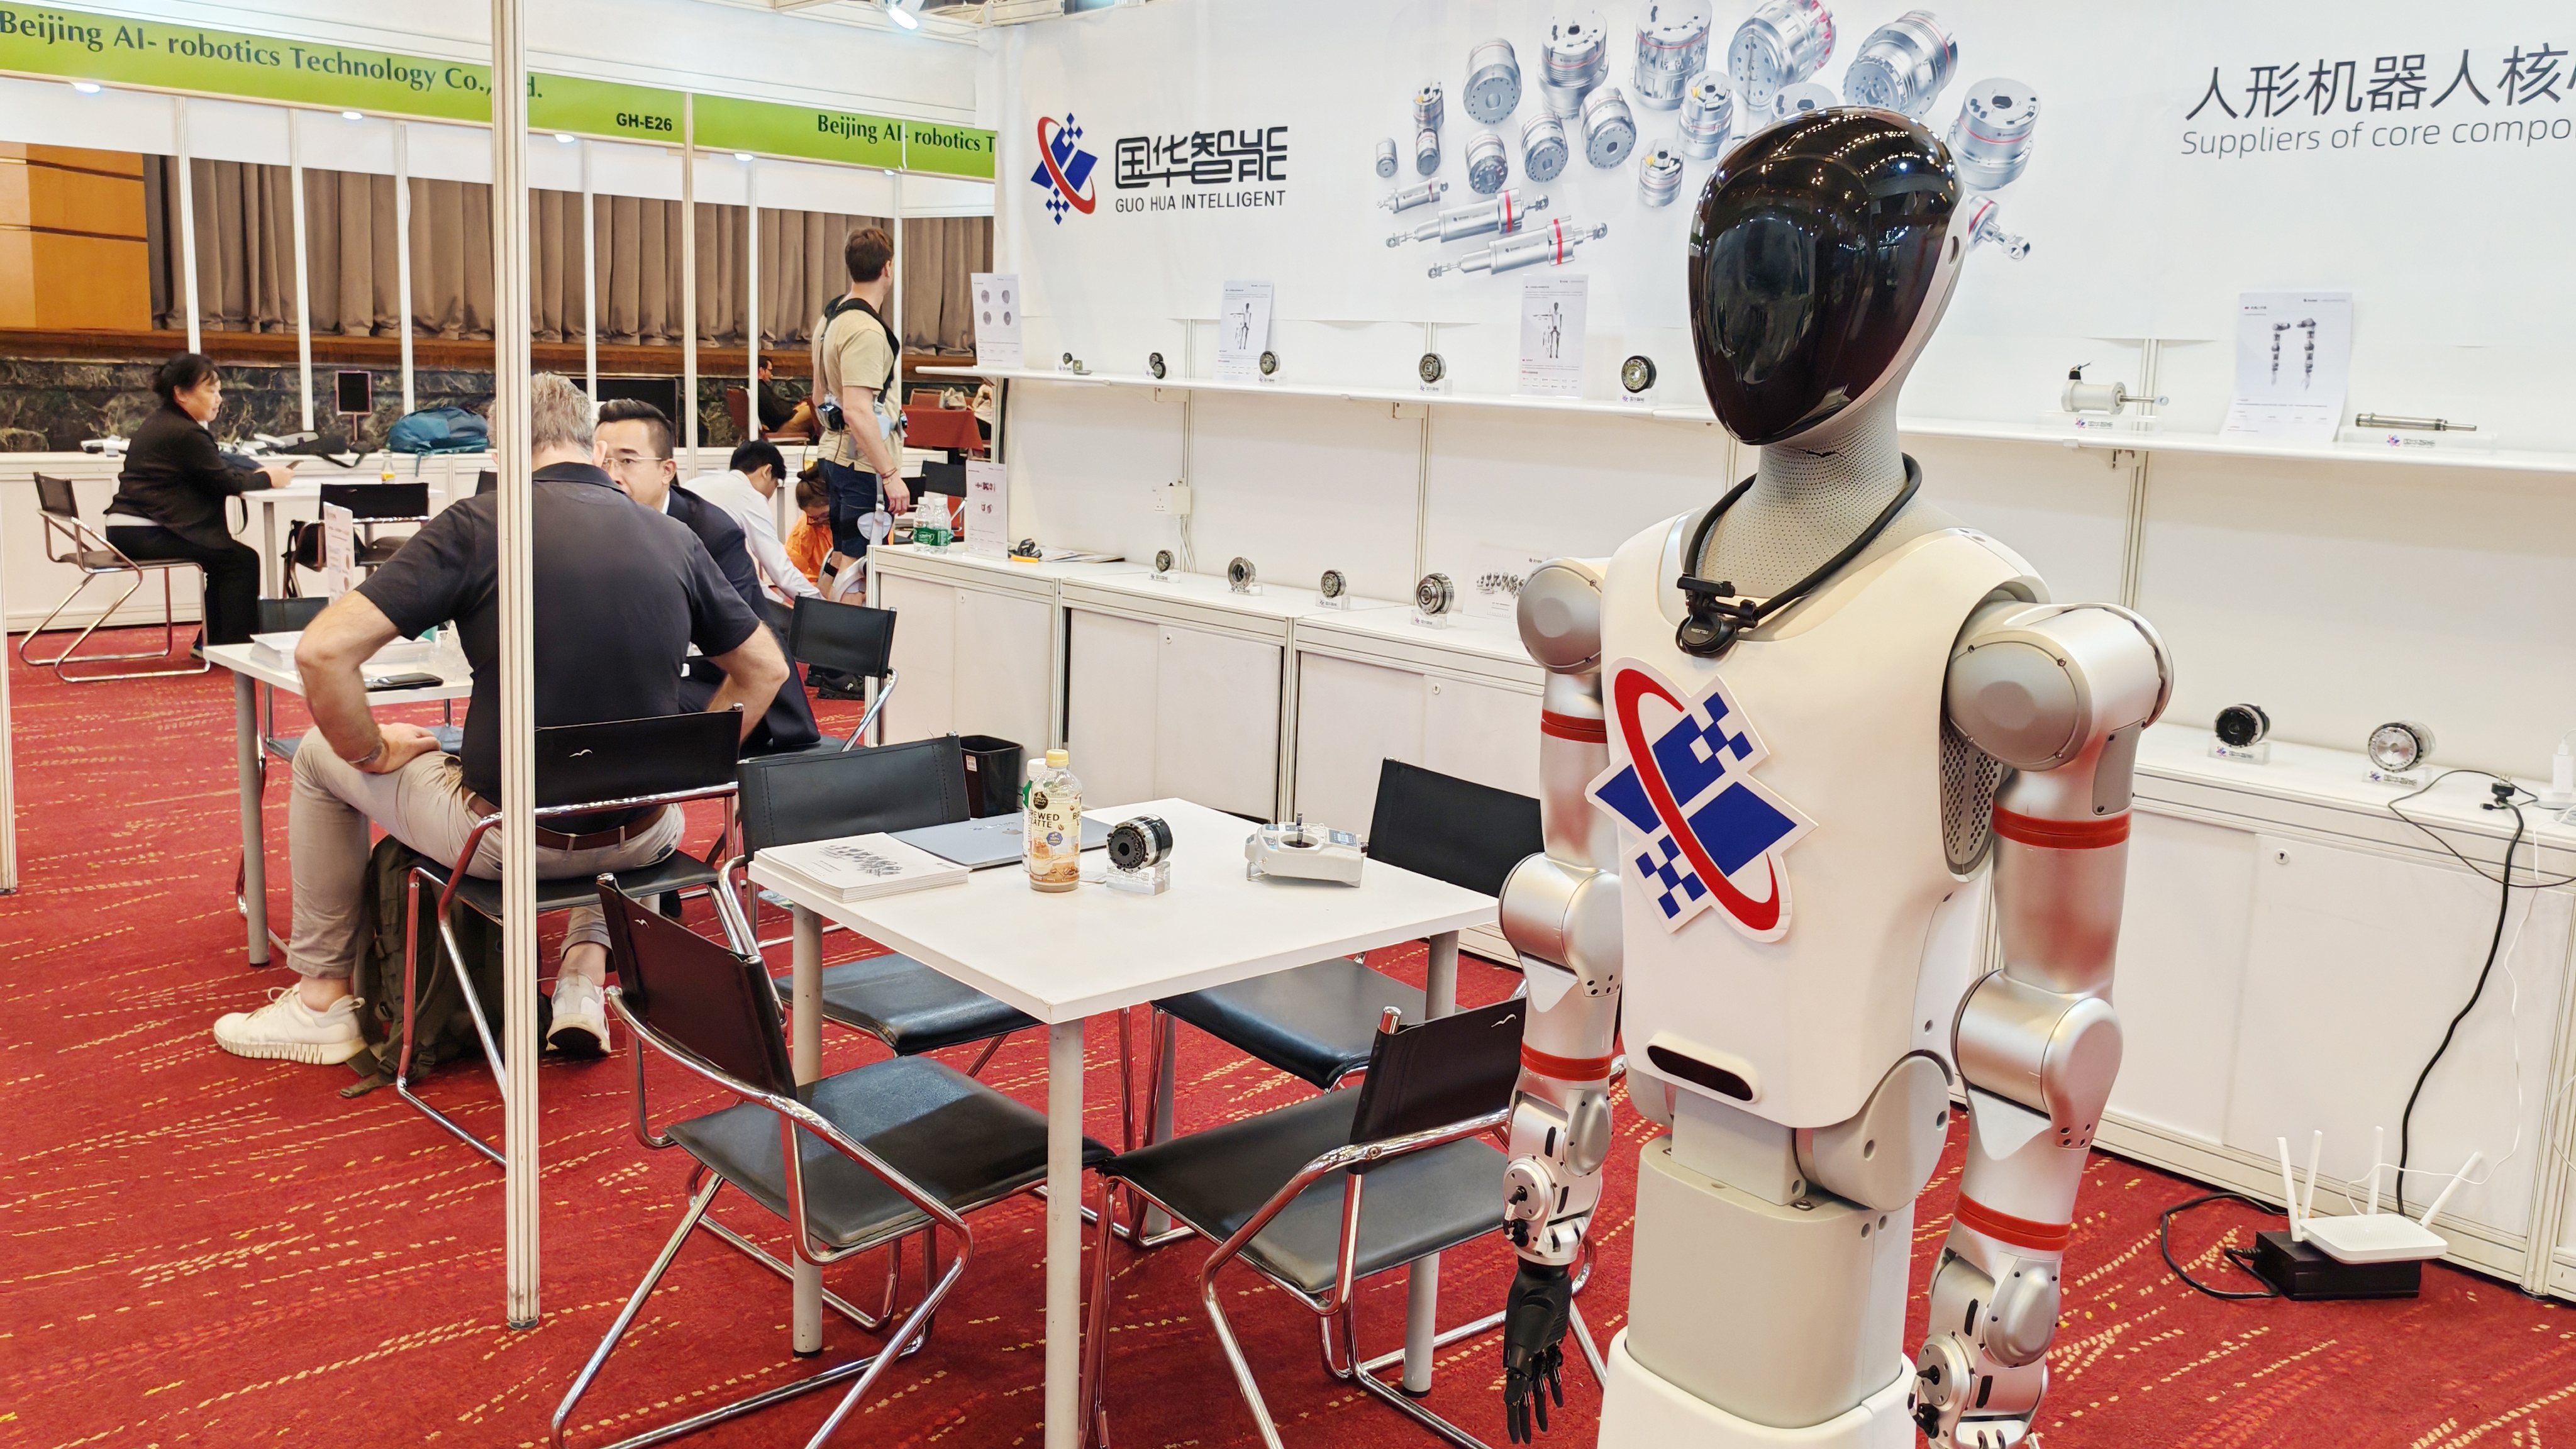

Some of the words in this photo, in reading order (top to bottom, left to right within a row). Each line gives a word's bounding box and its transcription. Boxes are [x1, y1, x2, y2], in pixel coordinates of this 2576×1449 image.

[0, 11, 103, 52] Beijing
[114, 26, 157, 50] AI-
[169, 33, 280, 66] robotics
[289, 47, 436, 92] Technology
[445, 68, 492, 96] Co.,
[2185, 43, 2576, 121] 人形机器人核
[616, 113, 672, 131] GH-E26
[818, 114, 878, 145] Beijing
[914, 128, 980, 152] robotics
[2181, 126, 2321, 160] Suppliers
[2331, 121, 2365, 149] of
[2372, 125, 2440, 147] core
[2452, 118, 2576, 147] compo
[1115, 126, 1288, 189] 国华智能
[1115, 197, 1145, 213] GUO
[1150, 195, 1176, 211] HUA
[1181, 190, 1286, 209] INTELLIGENT
